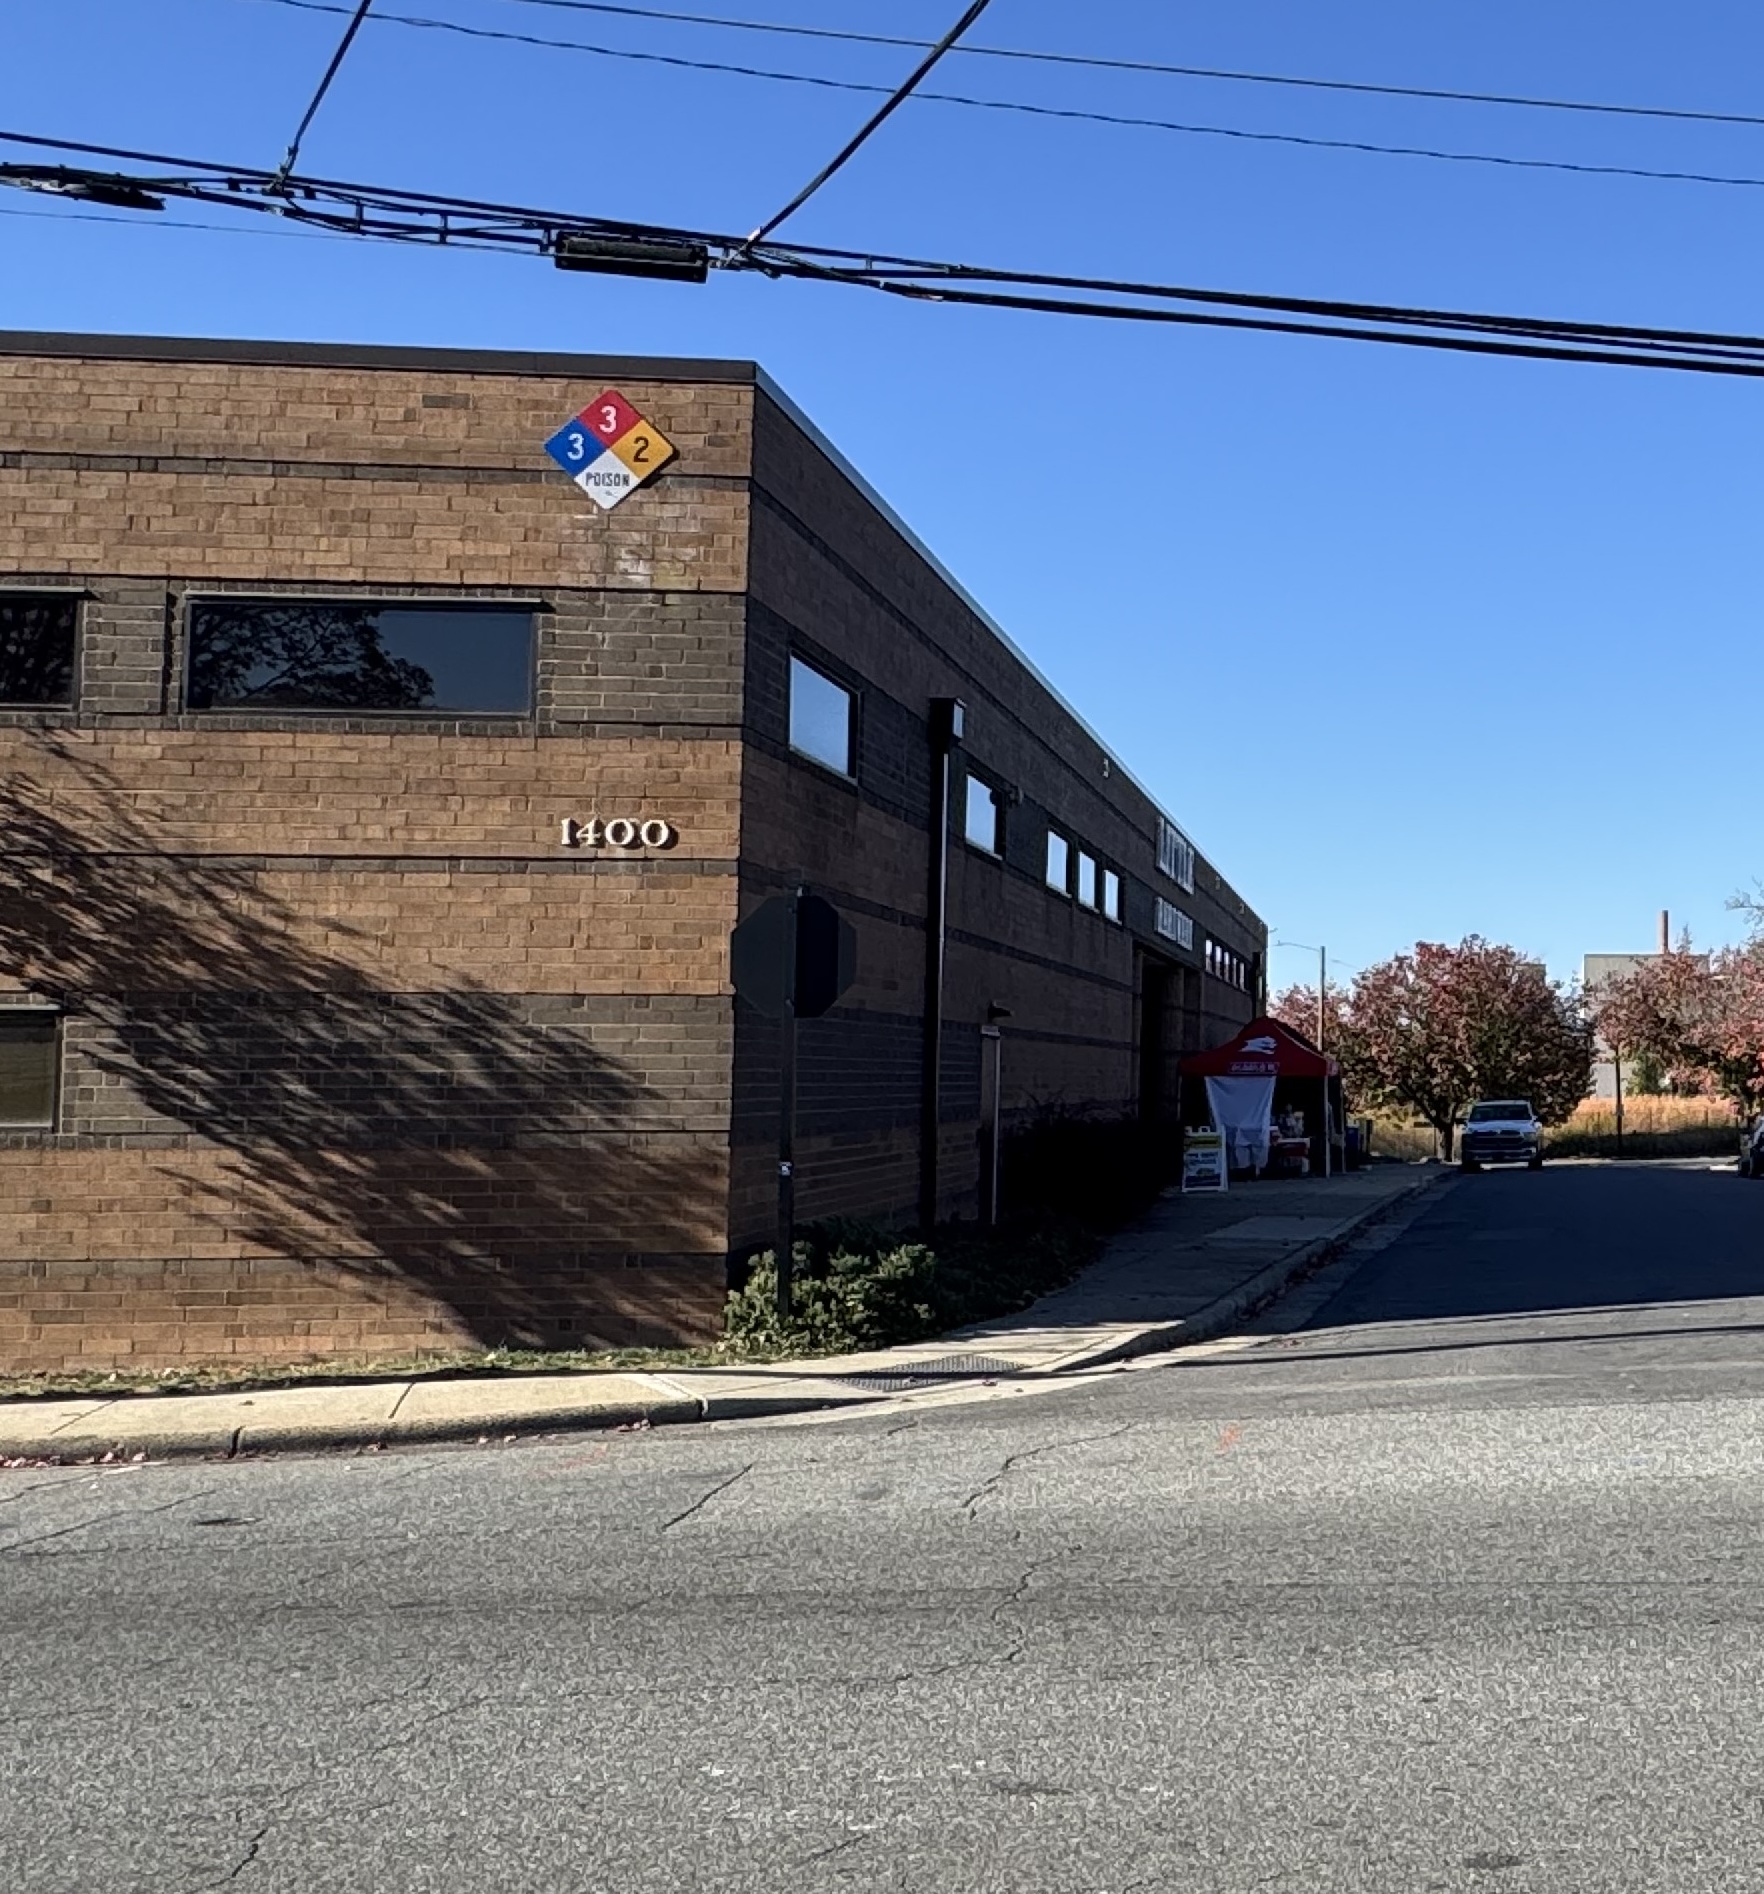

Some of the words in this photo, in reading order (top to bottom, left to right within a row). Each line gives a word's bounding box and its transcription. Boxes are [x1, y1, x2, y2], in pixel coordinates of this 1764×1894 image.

[599, 405, 617, 433] 3
[567, 433, 585, 460] 3
[633, 436, 649, 462] 2
[585, 472, 630, 487] POISON
[561, 817, 669, 847] 1400
